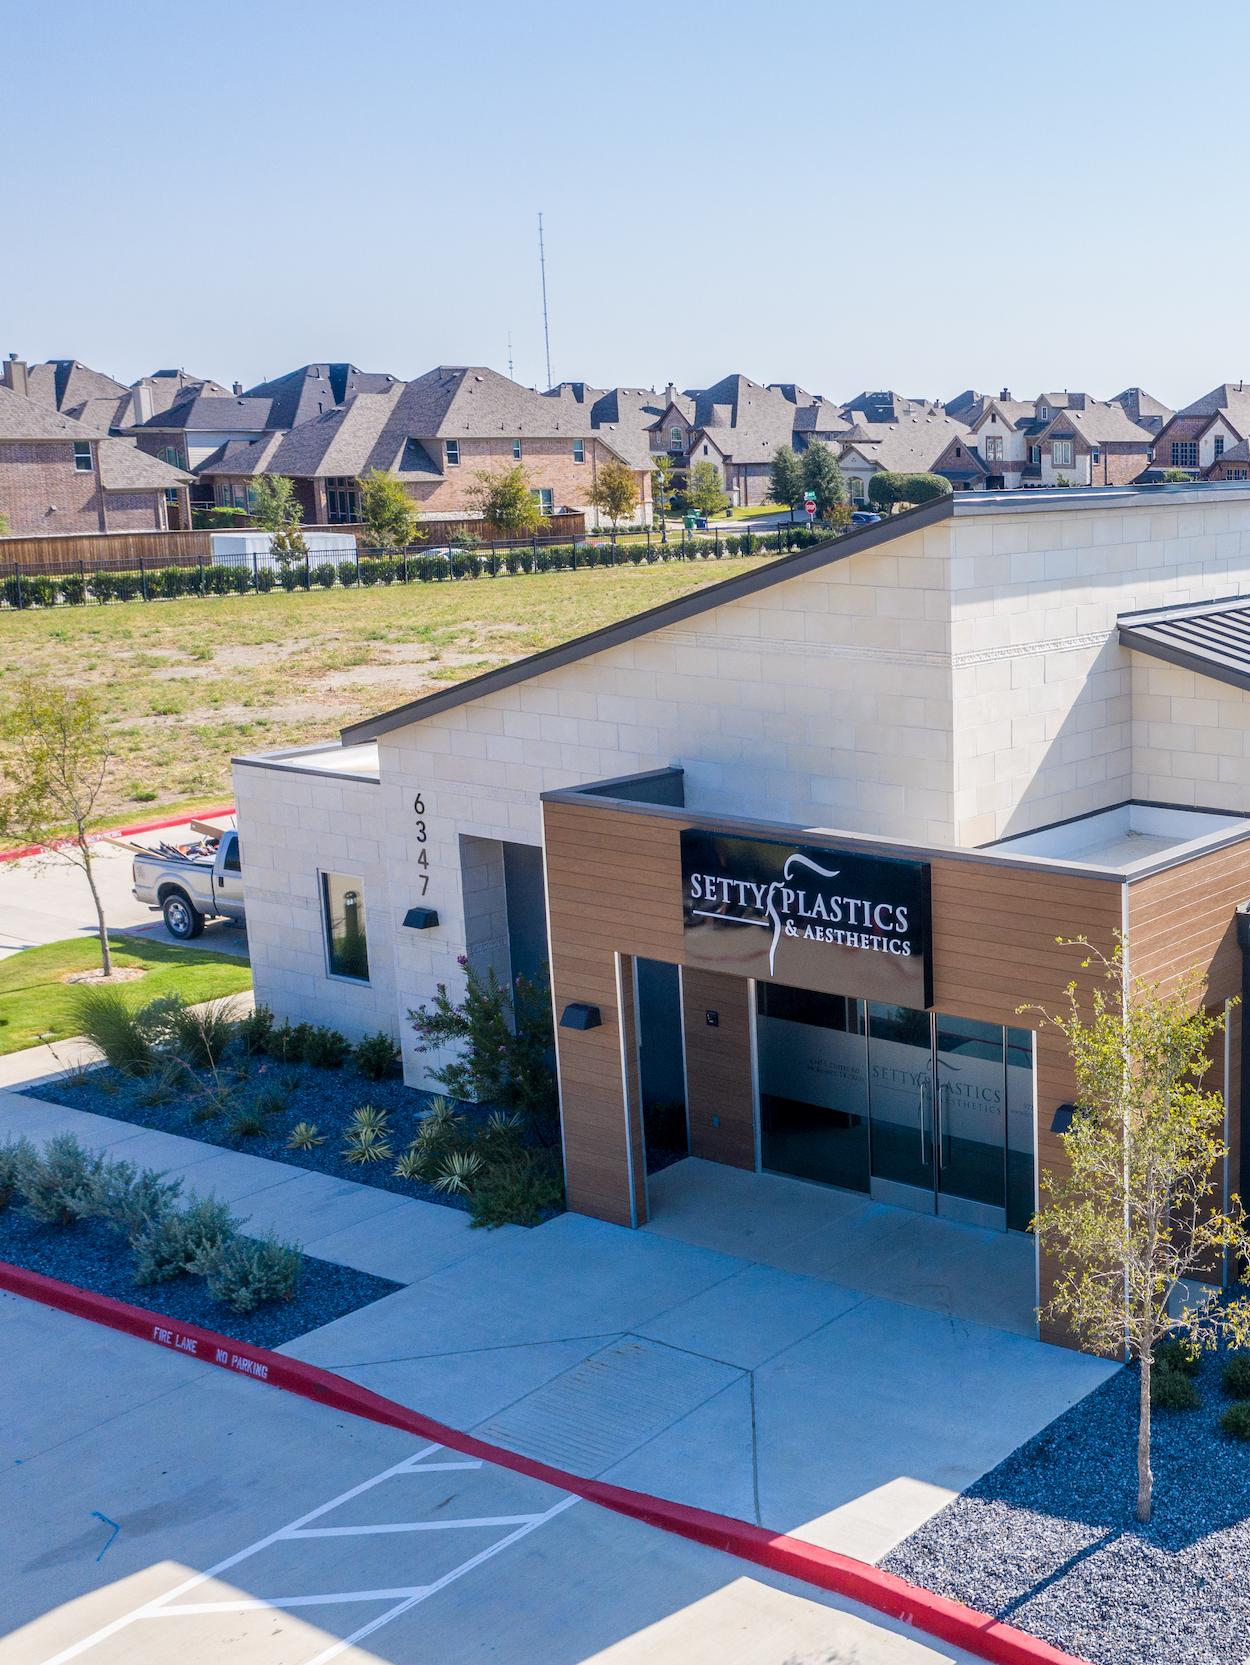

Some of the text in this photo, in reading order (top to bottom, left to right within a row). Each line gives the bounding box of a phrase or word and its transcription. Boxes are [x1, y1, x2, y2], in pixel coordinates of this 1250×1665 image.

[414, 792, 429, 896] 6347
[691, 873, 908, 933] SETTY PLASTICS
[785, 919, 912, 957] & AESTHETICS
[872, 1064, 917, 1087] SETTY
[153, 1326, 268, 1379] FIRE LANE NO PARKING
